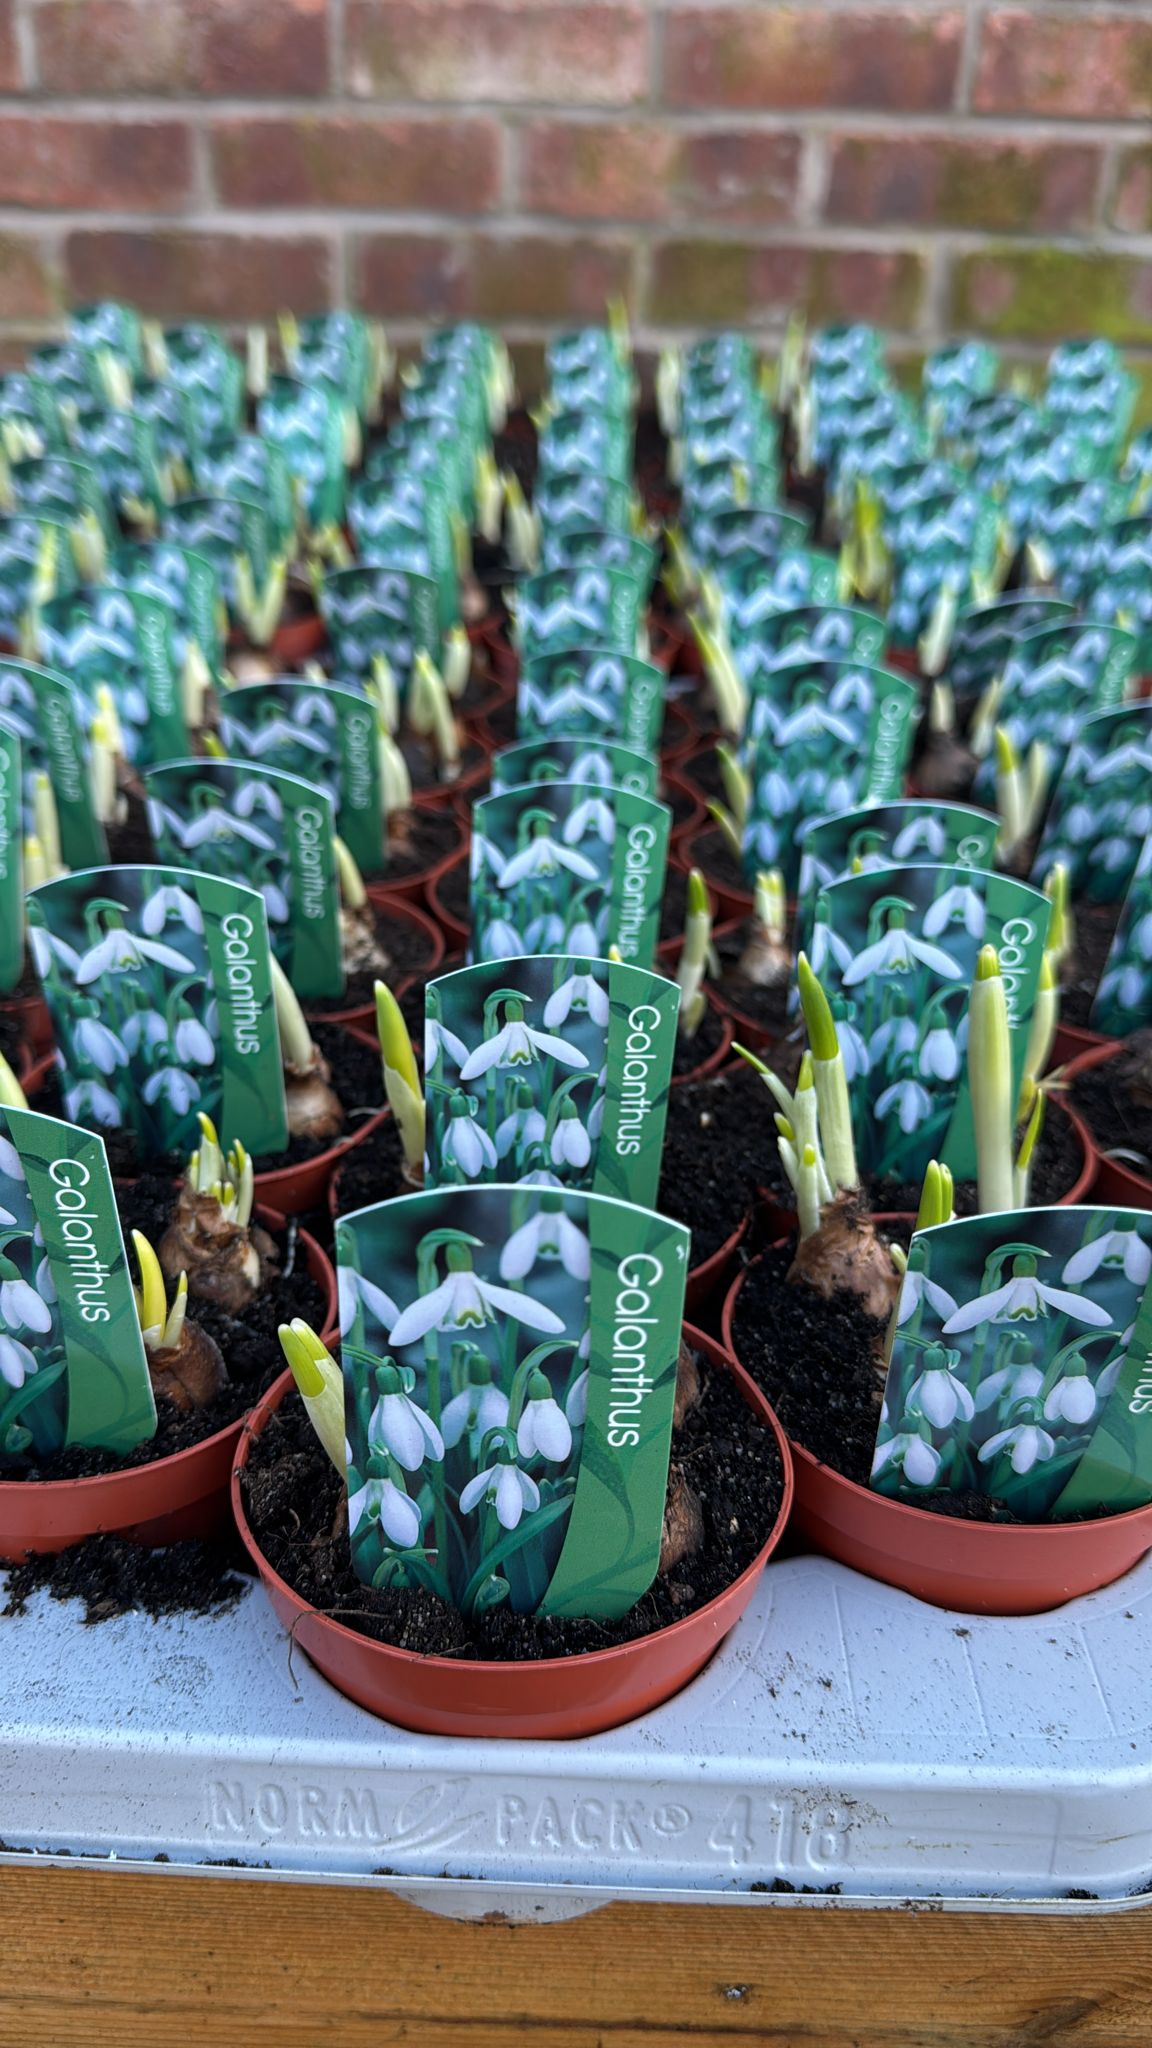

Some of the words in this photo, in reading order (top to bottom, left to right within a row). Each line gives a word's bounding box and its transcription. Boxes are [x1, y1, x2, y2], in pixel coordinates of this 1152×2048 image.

[296, 805, 326, 920] Galanthus
[617, 823, 657, 958] Galanthus
[222, 912, 262, 1055] Galanthus
[615, 1004, 662, 1156] Galanthus
[49, 1157, 111, 1322] Galanthus
[607, 1252, 664, 1448] Galanthus
[207, 1780, 382, 1839] NORM
